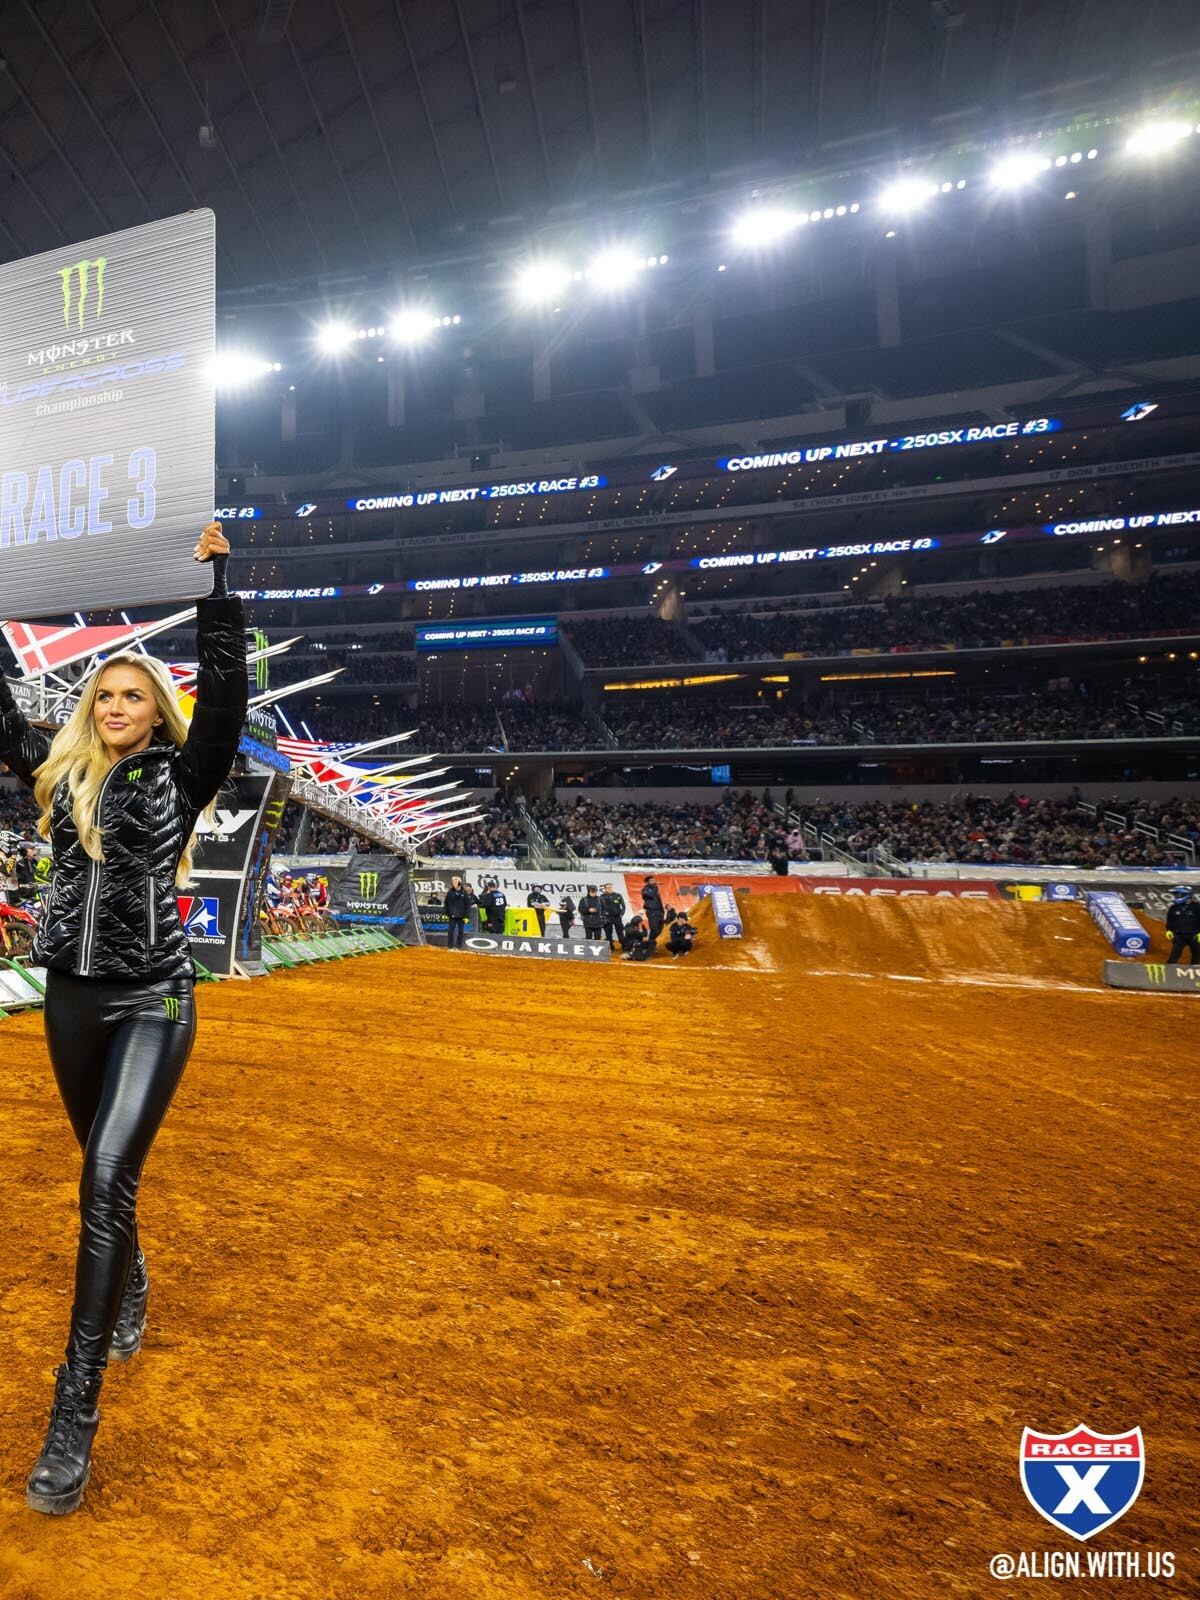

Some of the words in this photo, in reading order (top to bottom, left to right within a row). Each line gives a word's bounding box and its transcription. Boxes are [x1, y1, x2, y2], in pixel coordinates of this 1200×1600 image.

[27, 329, 137, 368] MONSTER
[43, 350, 119, 374] ENERGY
[35, 389, 124, 417] Championship
[727, 451, 802, 472] COMING
[805, 447, 833, 461] UP
[835, 439, 888, 459] NEXT
[900, 429, 965, 450] 250SX
[966, 421, 1020, 441] RACE
[1022, 418, 1049, 434] #3
[0, 453, 114, 549] RACE
[127, 446, 157, 529] 3
[355, 495, 413, 511] COMING
[417, 493, 438, 505] UP
[439, 488, 480, 504] NEXT
[489, 482, 536, 498] 250SX
[538, 477, 577, 493] RACE
[579, 475, 599, 488] #3
[214, 507, 236, 519] ACE
[238, 507, 255, 518] #3
[1053, 518, 1125, 536] COMING
[1129, 515, 1155, 528] UP
[1157, 510, 1200, 526] NEXT
[699, 554, 754, 569] COMING
[756, 552, 777, 564] UP
[777, 549, 818, 562] NEXT
[826, 543, 874, 558] 250SX
[874, 540, 911, 552] RACE
[912, 537, 932, 550] #3
[415, 579, 460, 591] COMING
[462, 576, 479, 588] UP
[480, 574, 511, 586] NEXT
[520, 571, 555, 583] 250SX
[556, 568, 586, 581] RACE
[588, 567, 603, 578] #3
[264, 589, 295, 599] 250SX
[296, 588, 321, 598] RACE
[322, 587, 336, 597] #3
[424, 632, 454, 641] COMING
[456, 631, 466, 639] UP
[467, 630, 487, 639] NEXT
[492, 629, 515, 637] 250SX
[516, 627, 534, 636] RACE
[535, 626, 546, 635] #3
[346, 901, 389, 911] MONSTER
[501, 940, 604, 956] OAKLEY
